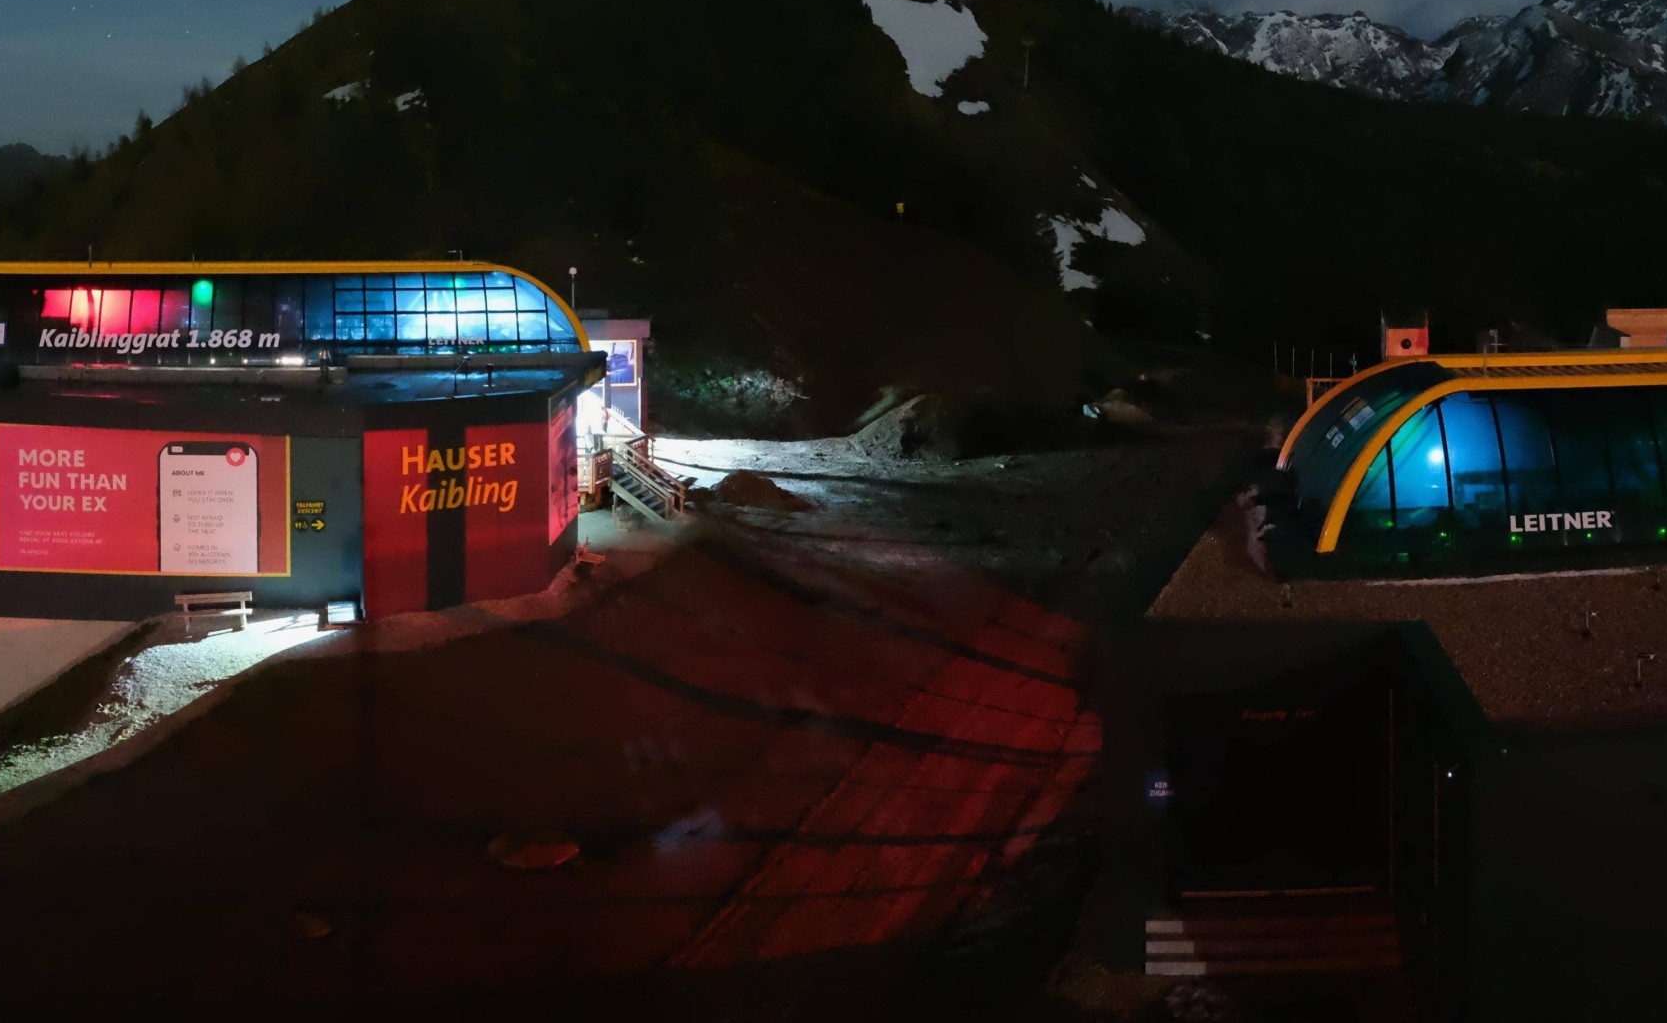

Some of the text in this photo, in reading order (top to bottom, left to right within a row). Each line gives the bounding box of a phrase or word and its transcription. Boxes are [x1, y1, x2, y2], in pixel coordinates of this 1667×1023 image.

[39, 328, 281, 354] Kaiblinggrat 1.868 m
[428, 336, 485, 346] LEITNER
[18, 448, 85, 467] MORE
[402, 442, 516, 475] HAUSER
[18, 471, 127, 490] FUN THAN
[20, 494, 107, 512] YOUR EX
[400, 476, 518, 514] Kaibling
[1509, 510, 1613, 532] LEITNER
